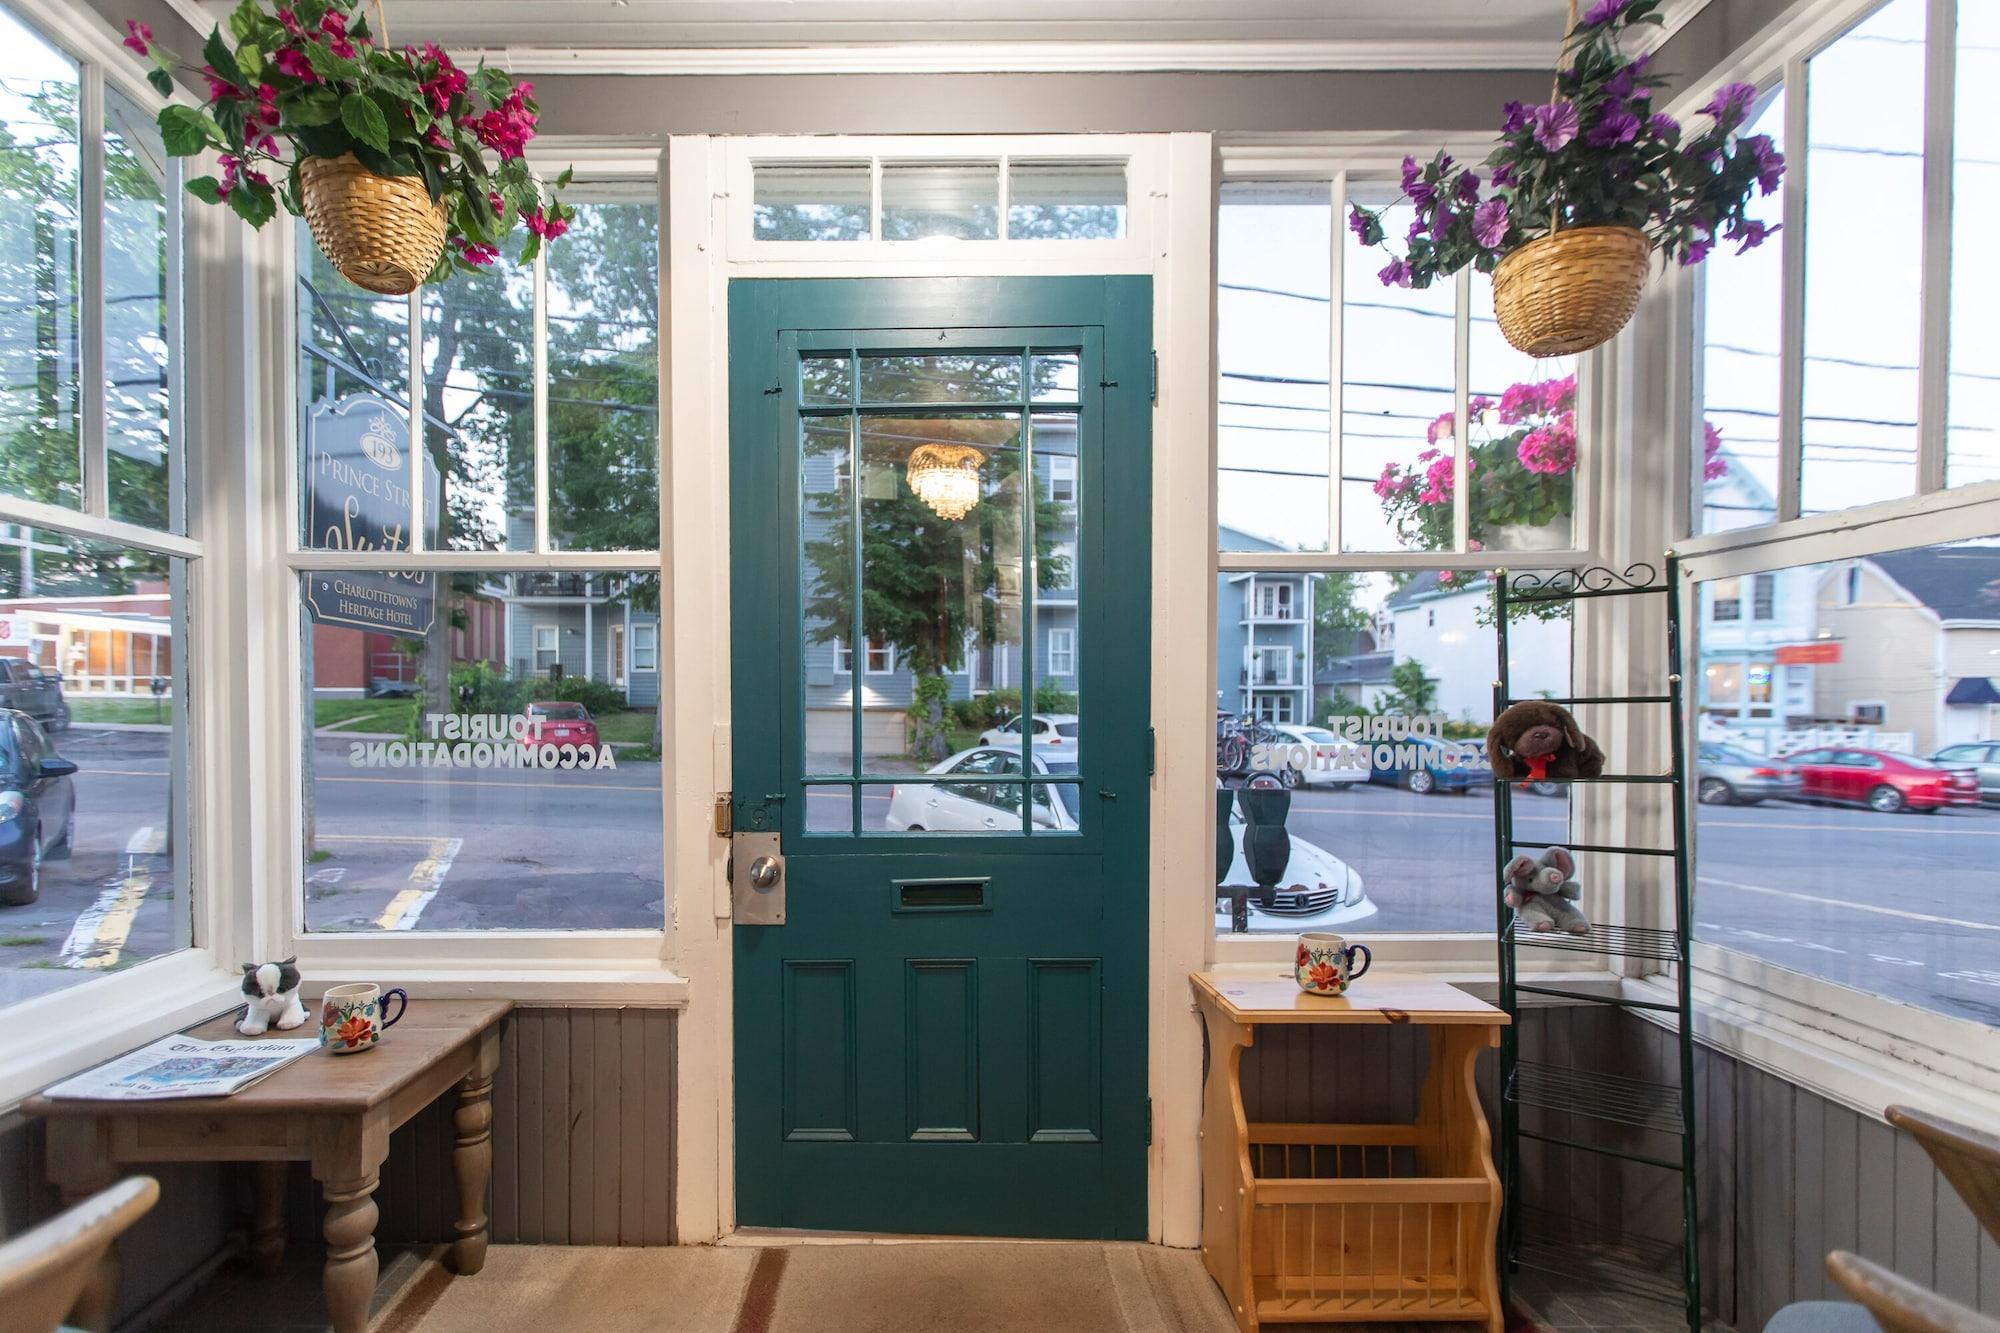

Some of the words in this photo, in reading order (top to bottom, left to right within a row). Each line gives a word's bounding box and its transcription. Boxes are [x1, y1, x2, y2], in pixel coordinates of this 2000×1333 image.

[372, 440, 393, 464] 193
[321, 451, 380, 497] PRINCE
[385, 480, 432, 517] STRT
[339, 599, 384, 621] HERITAGE
[386, 608, 413, 626] HOTEL
